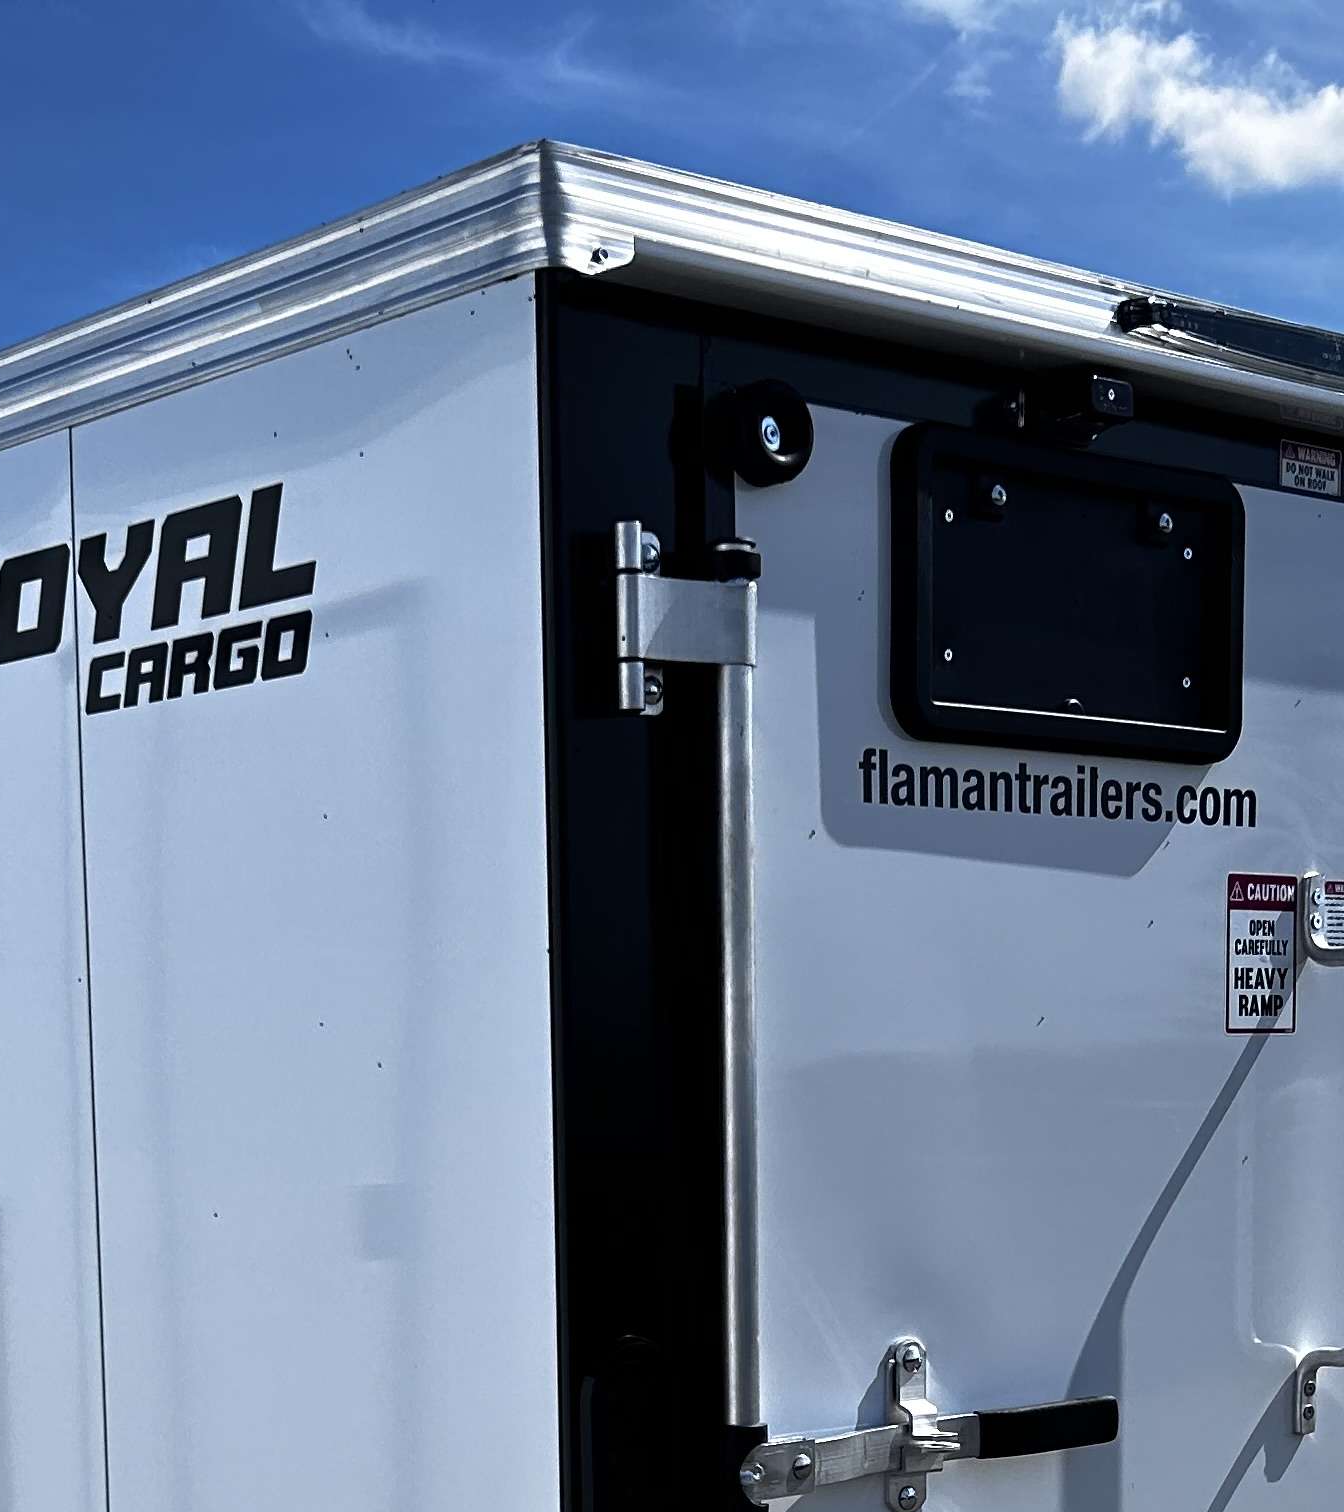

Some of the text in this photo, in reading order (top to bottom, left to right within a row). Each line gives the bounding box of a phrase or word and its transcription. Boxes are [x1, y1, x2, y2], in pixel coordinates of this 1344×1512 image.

[1297, 447, 1336, 466] WARNING
[1286, 462, 1336, 481] DO NOT WALK
[1294, 475, 1306, 488] ON
[85, 609, 313, 715] CARGO
[858, 748, 1256, 827] flamantrailers.com
[1247, 883, 1295, 902] CAUTION
[1249, 919, 1275, 937] OPEN
[1234, 939, 1289, 956] CAREFULLY
[1233, 967, 1289, 990] HEAVY
[1238, 994, 1284, 1017] RAMP
